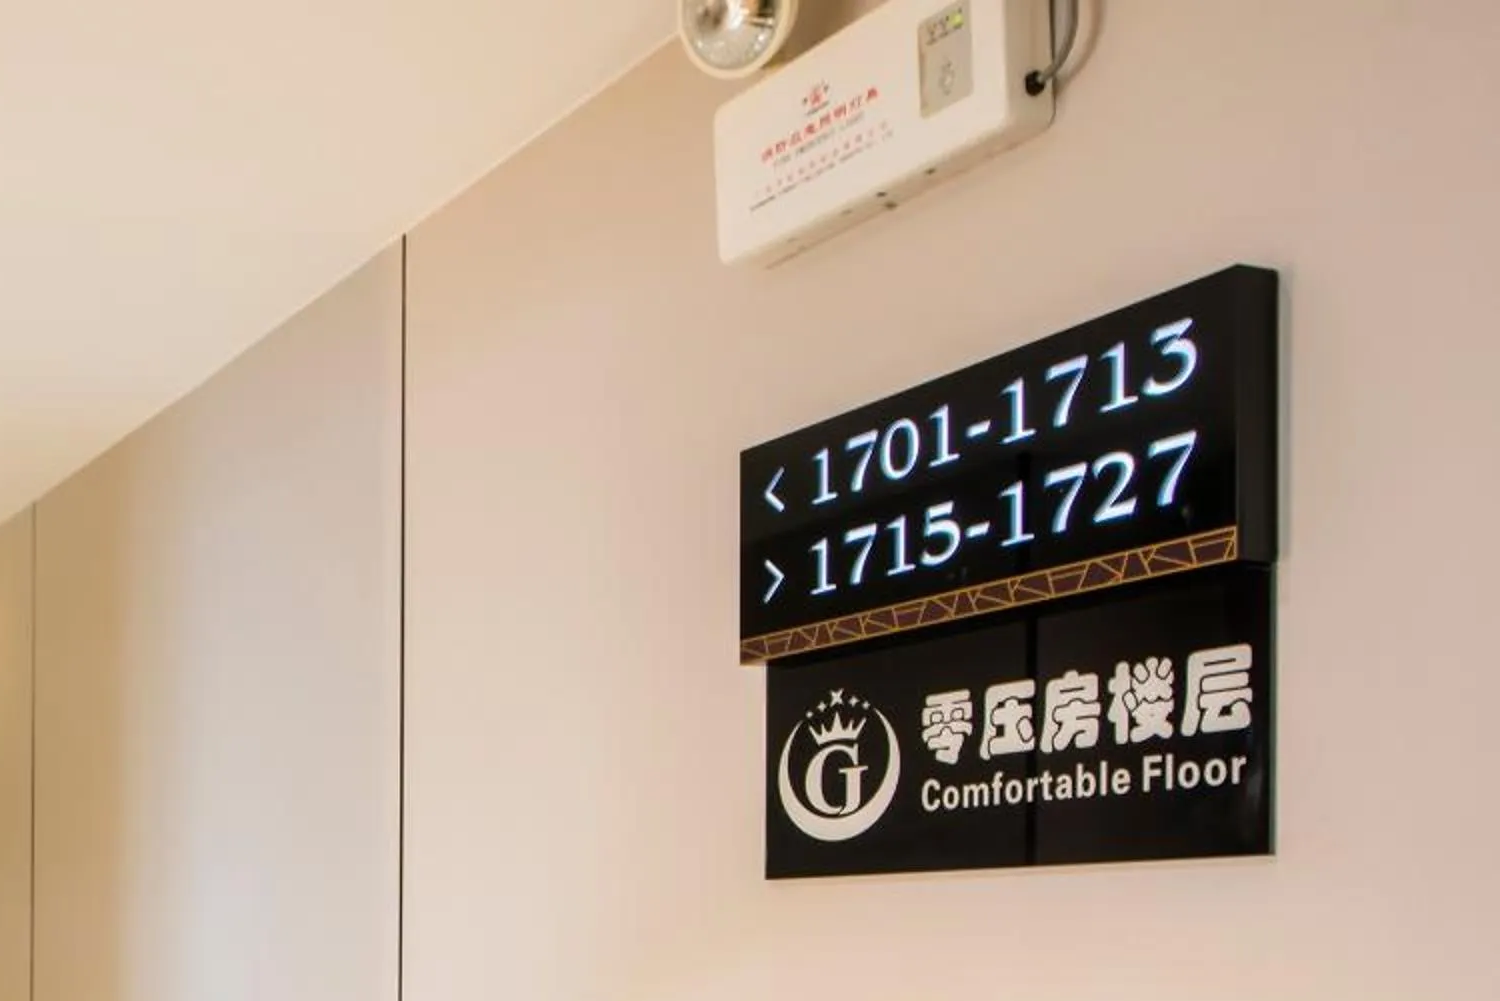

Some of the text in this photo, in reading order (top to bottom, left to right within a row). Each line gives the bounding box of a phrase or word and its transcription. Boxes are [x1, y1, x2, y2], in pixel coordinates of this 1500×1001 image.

[811, 316, 1198, 505] 1701-1713
[808, 430, 1198, 596] 1715-1727
[922, 643, 1253, 765] 零压房楼层
[921, 753, 1247, 812] Comfortable Floor
